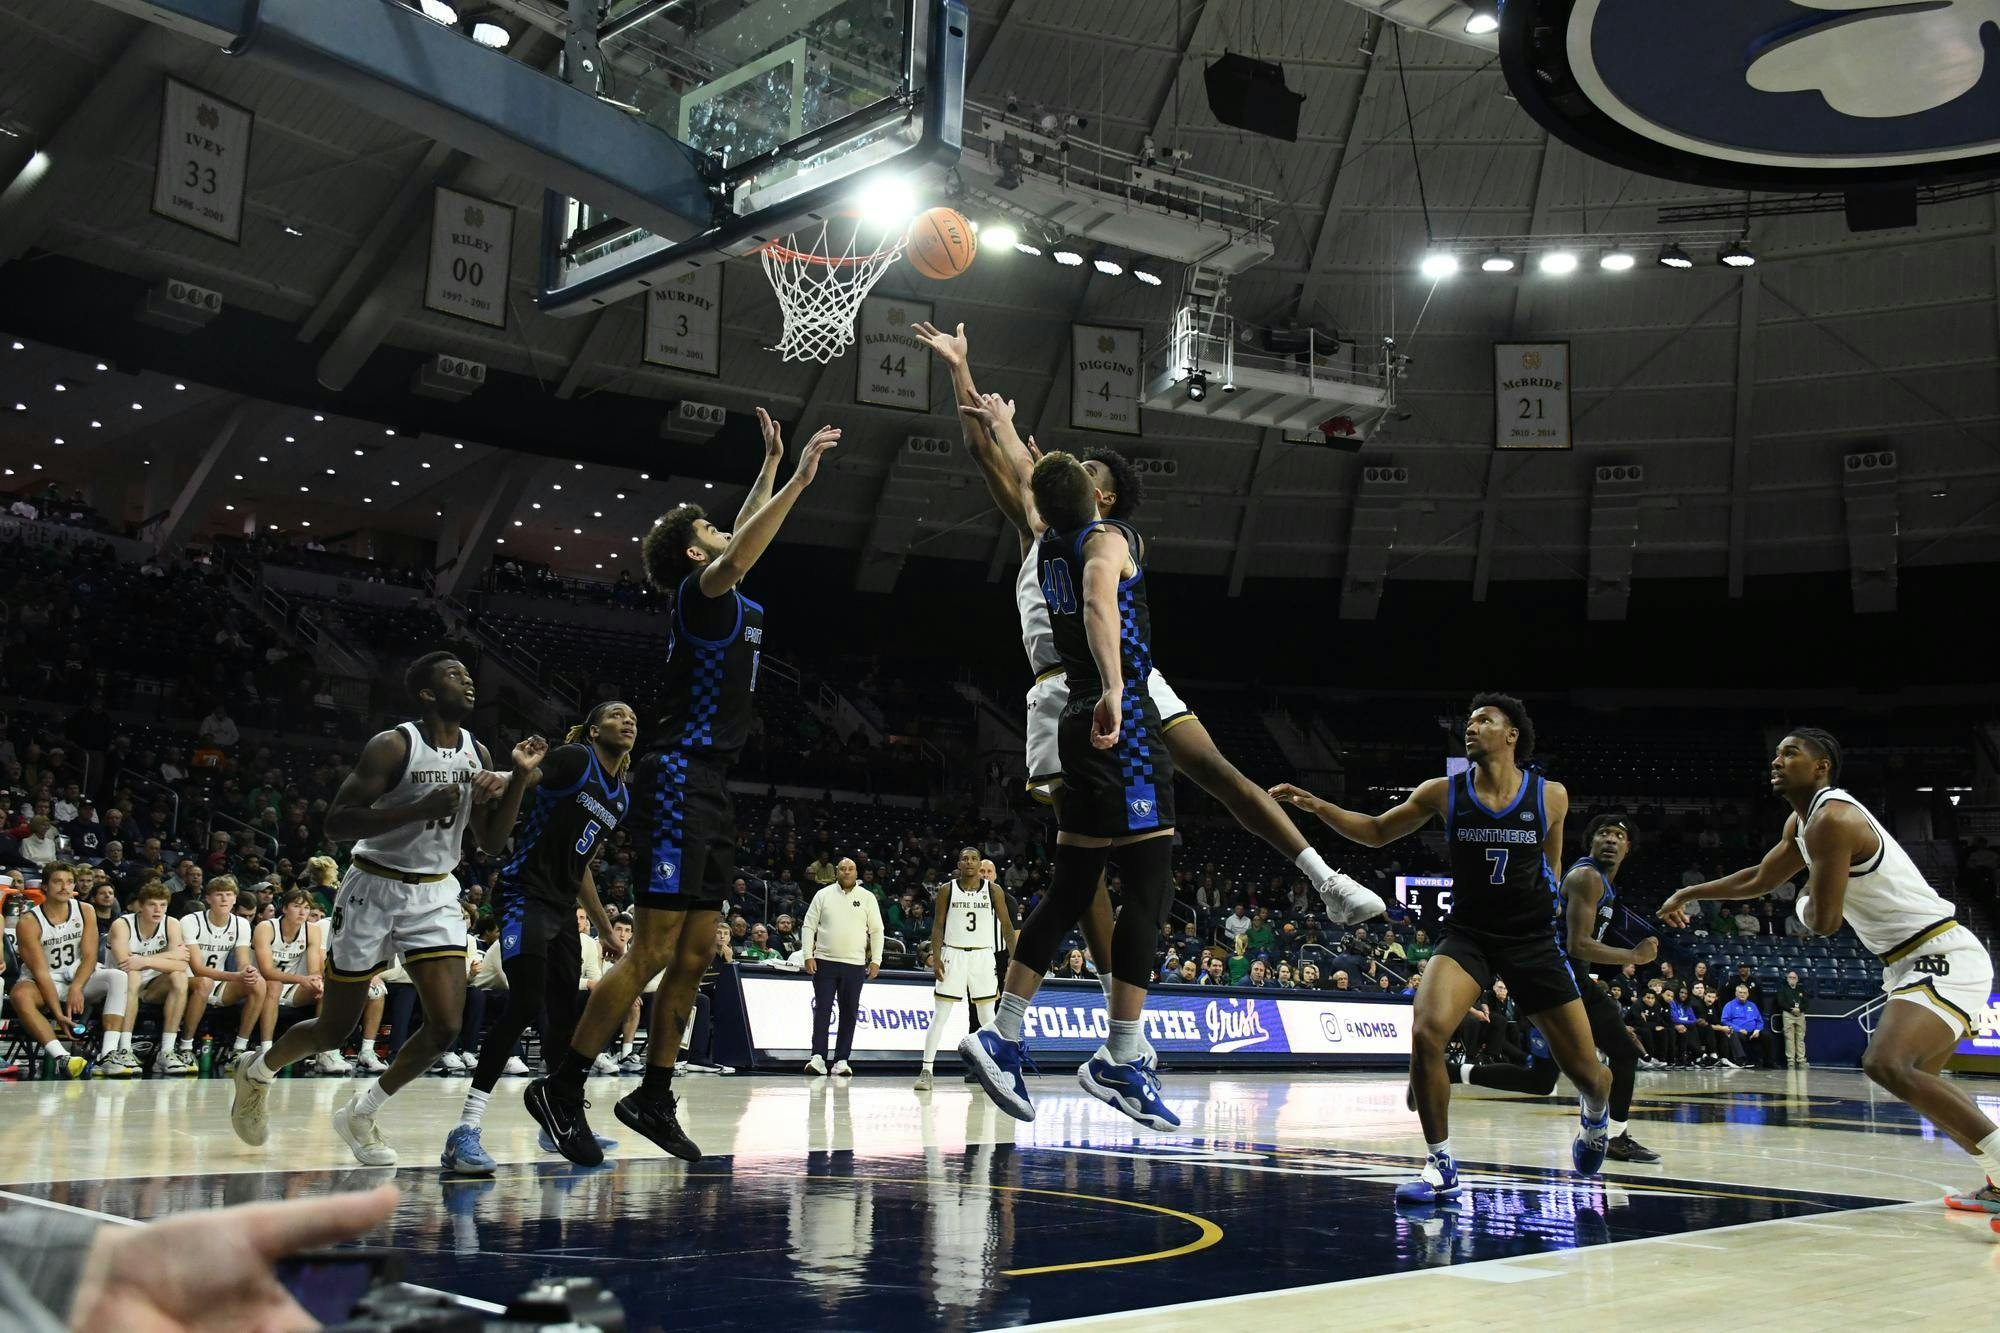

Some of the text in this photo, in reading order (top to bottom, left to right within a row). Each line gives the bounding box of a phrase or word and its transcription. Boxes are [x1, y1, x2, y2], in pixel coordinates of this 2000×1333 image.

[186, 132, 225, 156] IVEY
[184, 160, 217, 194] 33
[203, 207, 224, 223] 2001
[451, 233, 493, 253] RILEY
[453, 257, 483, 287] 00
[442, 289, 462, 302] 1997
[655, 290, 714, 311] MURPHY
[676, 314, 688, 337] 3
[864, 333, 927, 352] HARANGODY
[686, 349, 704, 360] 2001
[879, 354, 907, 377] 44
[1080, 360, 1134, 376] DIGGINS
[1098, 381, 1110, 401] 4
[1503, 377, 1562, 391] McBRIDE
[1519, 398, 1544, 419] 21
[1041, 557, 1077, 615] 40
[411, 770, 448, 784] NOTRE
[575, 819, 601, 855] 5
[1457, 828, 1537, 844] PANTHERS
[1485, 848, 1509, 885] 7
[1414, 878, 1443, 886] NOTRE
[951, 901, 971, 909] NOTRE
[966, 911, 977, 932] 3
[42, 930, 82, 946] NOTRE DAME
[198, 943, 216, 951] OTRE
[50, 943, 75, 969] 33
[206, 954, 218, 969] 6
[1023, 997, 1269, 1048] FOLLO THE Irish
[1343, 1018, 1398, 1038] @NDMBB
